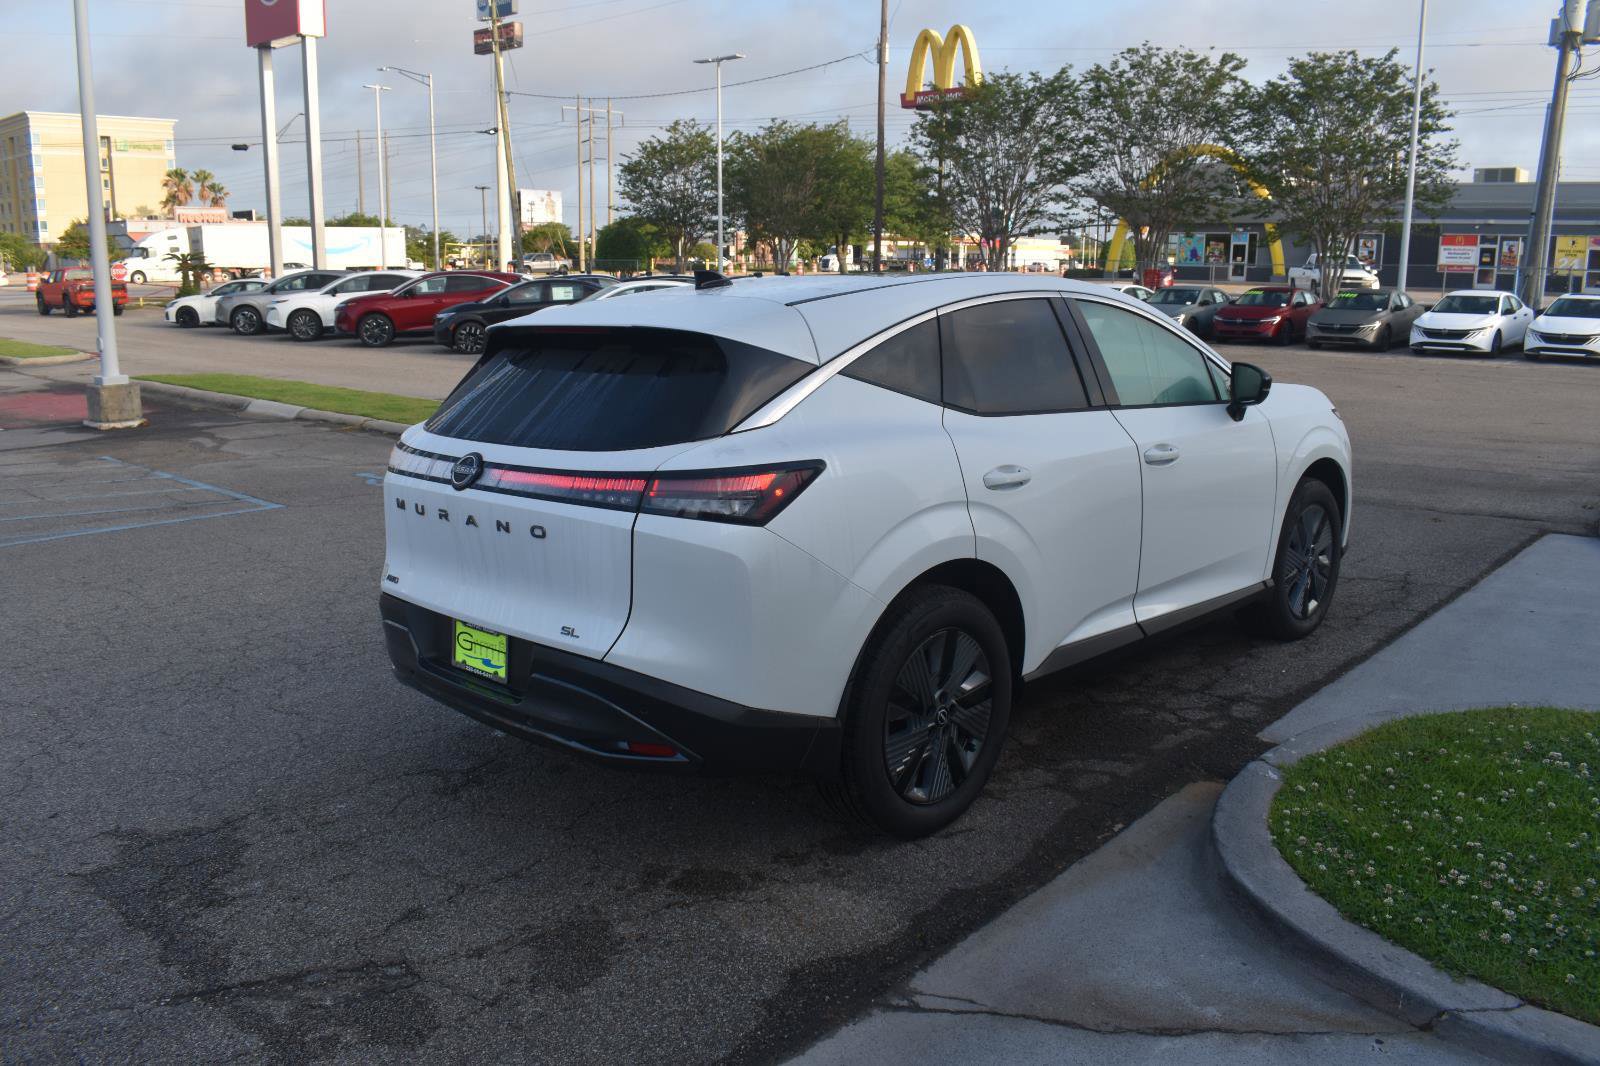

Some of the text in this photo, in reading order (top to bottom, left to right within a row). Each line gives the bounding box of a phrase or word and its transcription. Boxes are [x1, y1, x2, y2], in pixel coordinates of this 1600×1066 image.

[112, 266, 127, 275] STOP
[396, 497, 547, 539] MURANO
[560, 625, 580, 639] SL
